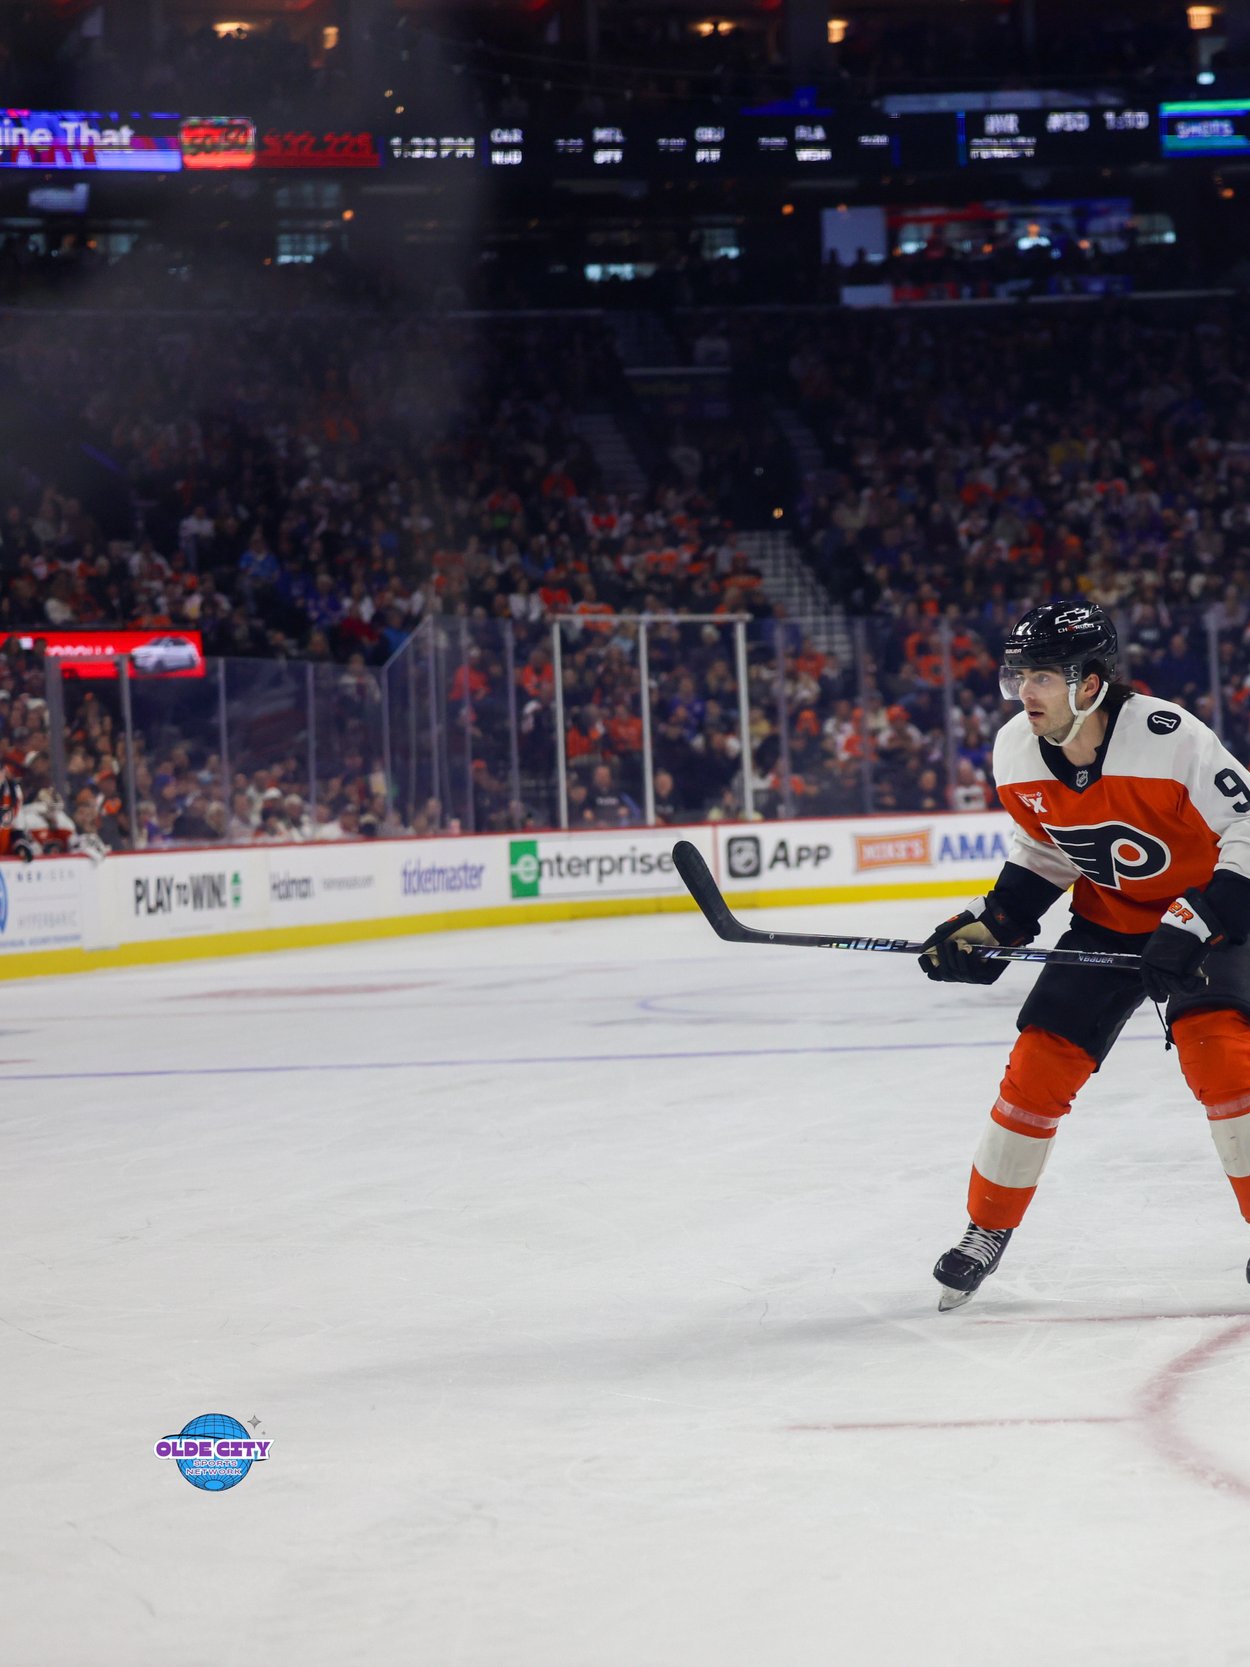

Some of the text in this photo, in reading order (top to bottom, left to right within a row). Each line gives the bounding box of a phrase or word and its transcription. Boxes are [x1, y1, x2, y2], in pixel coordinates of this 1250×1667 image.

[59, 120, 134, 155] That
[938, 833, 1013, 861] AMA
[402, 859, 485, 895] ticketmaster
[510, 847, 675, 884] enterprise
[134, 876, 174, 916] PLAY
